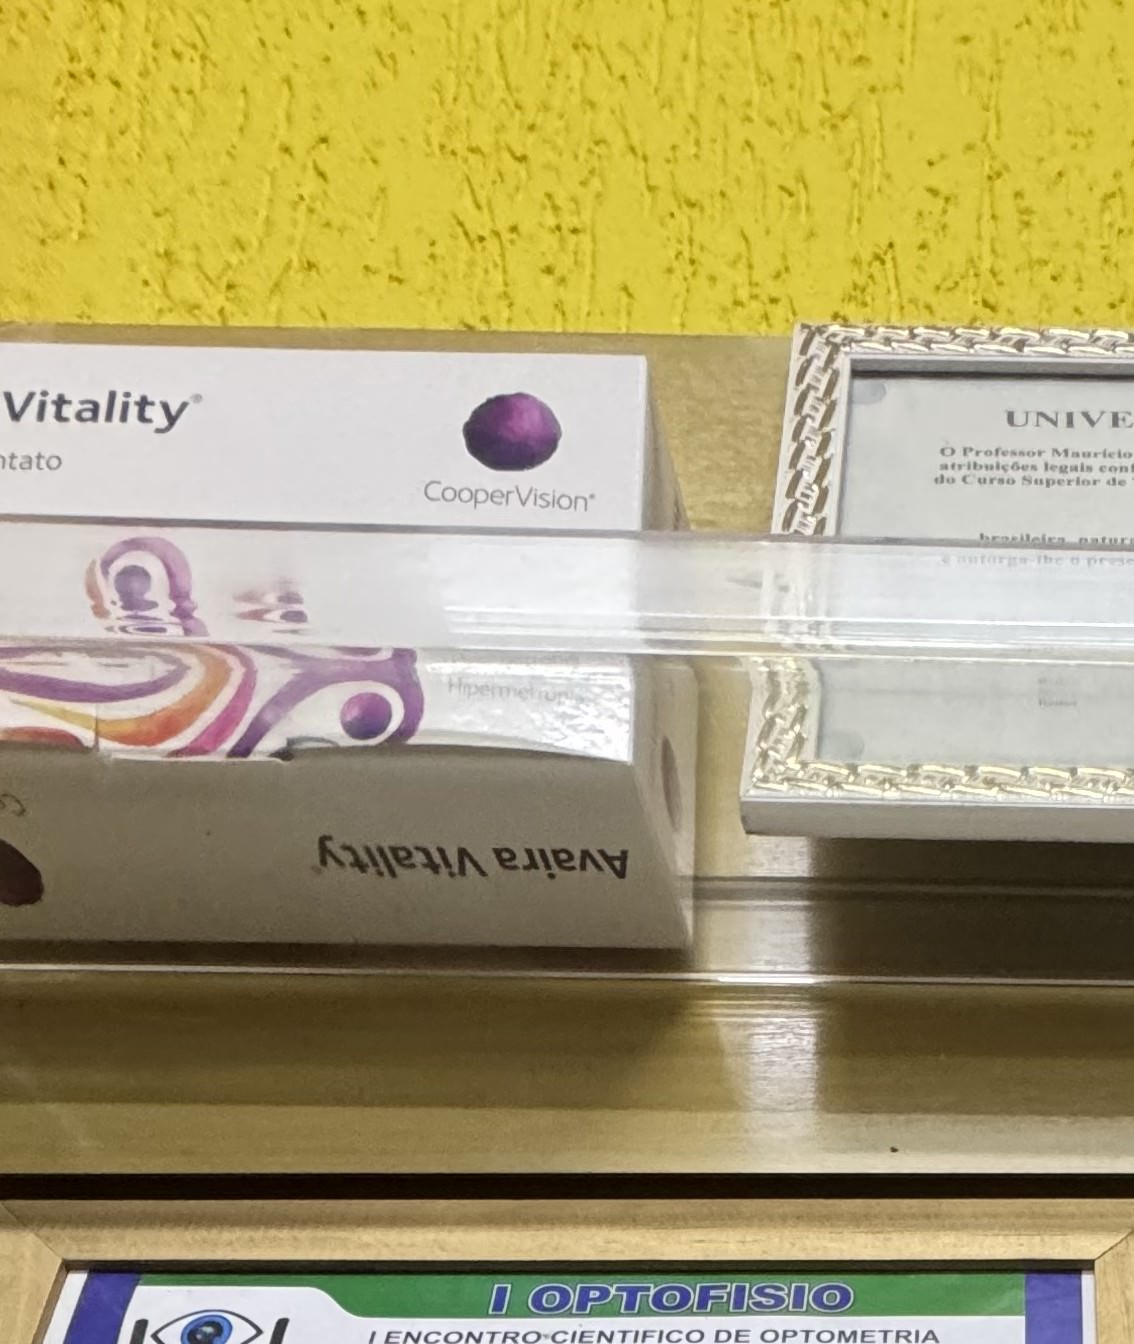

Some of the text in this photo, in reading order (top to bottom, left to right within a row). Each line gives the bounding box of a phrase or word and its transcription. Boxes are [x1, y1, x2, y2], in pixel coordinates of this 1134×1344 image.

[492, 847, 629, 880] Avaira
[489, 1282, 854, 1315] I OPTOFISIO
[714, 1329, 752, 1344] DE
[759, 1329, 941, 1344] OPTOMETRIA
